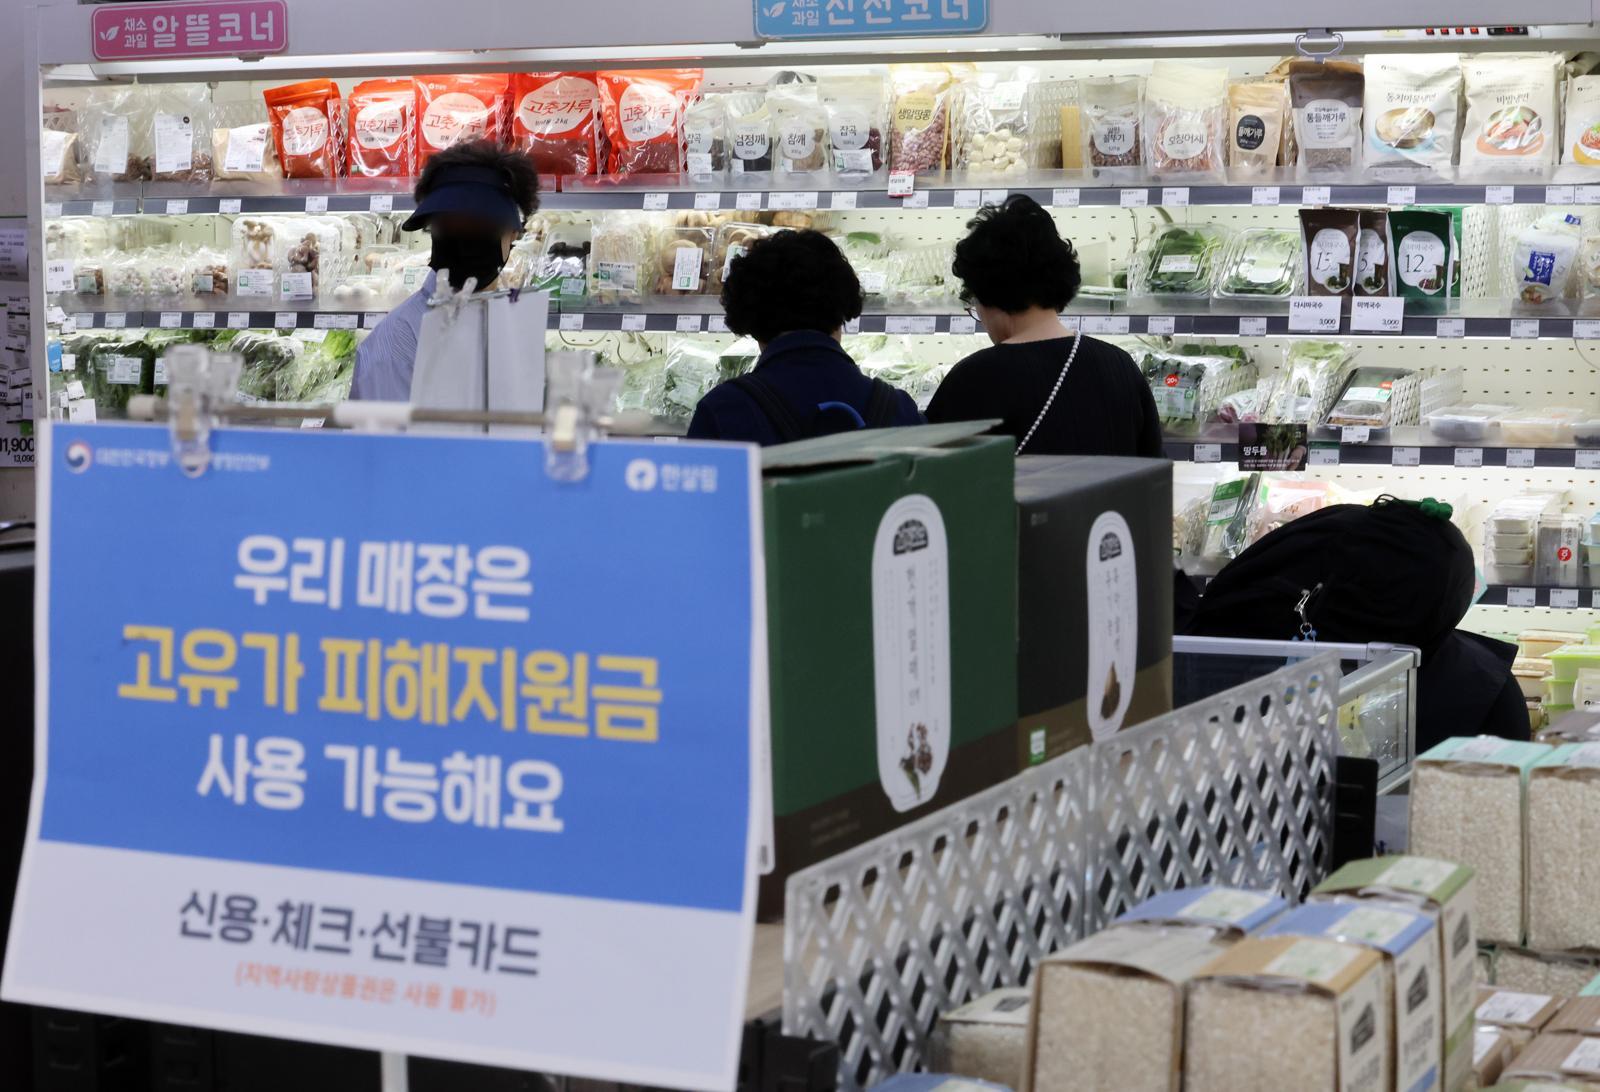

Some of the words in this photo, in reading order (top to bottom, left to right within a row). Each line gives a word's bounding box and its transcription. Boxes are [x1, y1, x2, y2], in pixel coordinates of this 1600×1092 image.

[792, 10, 820, 26] 과일
[826, 0, 969, 26] 신선코너
[124, 17, 147, 32] 채소
[152, 10, 274, 48] 알뜰코너
[124, 34, 147, 49] 과일
[525, 99, 593, 116] 고춧가루
[1307, 112, 1346, 123] 통들깨가루
[839, 125, 857, 137] 잡곡
[1238, 127, 1263, 139] 들깨가루
[735, 133, 766, 147] 검정깨
[787, 133, 806, 147] 참깨
[1405, 254, 1425, 273] 12
[1293, 301, 1323, 309] 다시마국수
[1357, 301, 1382, 309] 미역국수
[1319, 318, 1337, 326] 3,000
[1382, 318, 1400, 327] 3,000
[1243, 446, 1268, 456] 땅두릅
[235, 534, 345, 609] 우리
[357, 539, 534, 621] 매장은
[117, 625, 304, 713] 고유가
[318, 638, 663, 742] 피해지원금
[197, 733, 306, 810] 사용
[324, 744, 565, 833] 가능해요
[405, 982, 442, 1008] 사용
